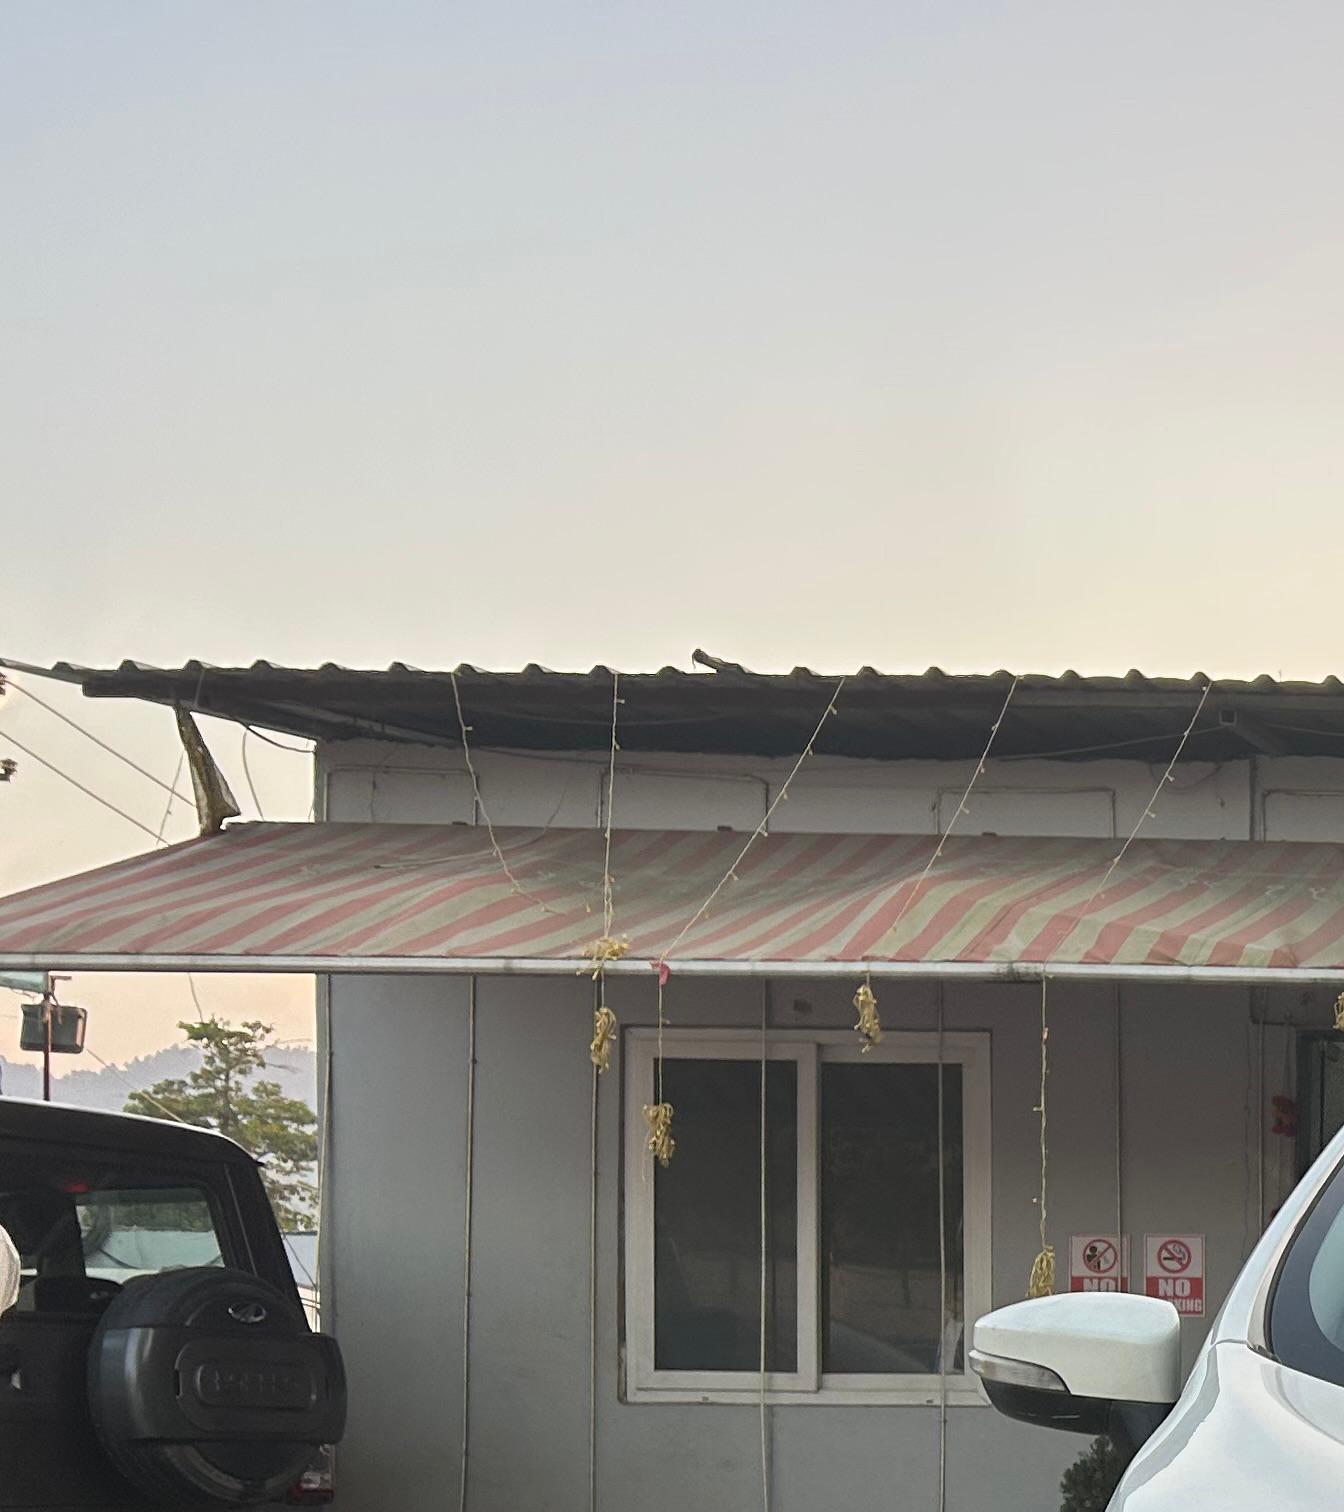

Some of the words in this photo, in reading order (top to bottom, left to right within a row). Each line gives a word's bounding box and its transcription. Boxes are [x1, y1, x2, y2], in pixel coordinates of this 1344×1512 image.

[1083, 1278, 1116, 1292] NO
[1158, 1278, 1191, 1297] NO
[1167, 1298, 1202, 1312] KING
